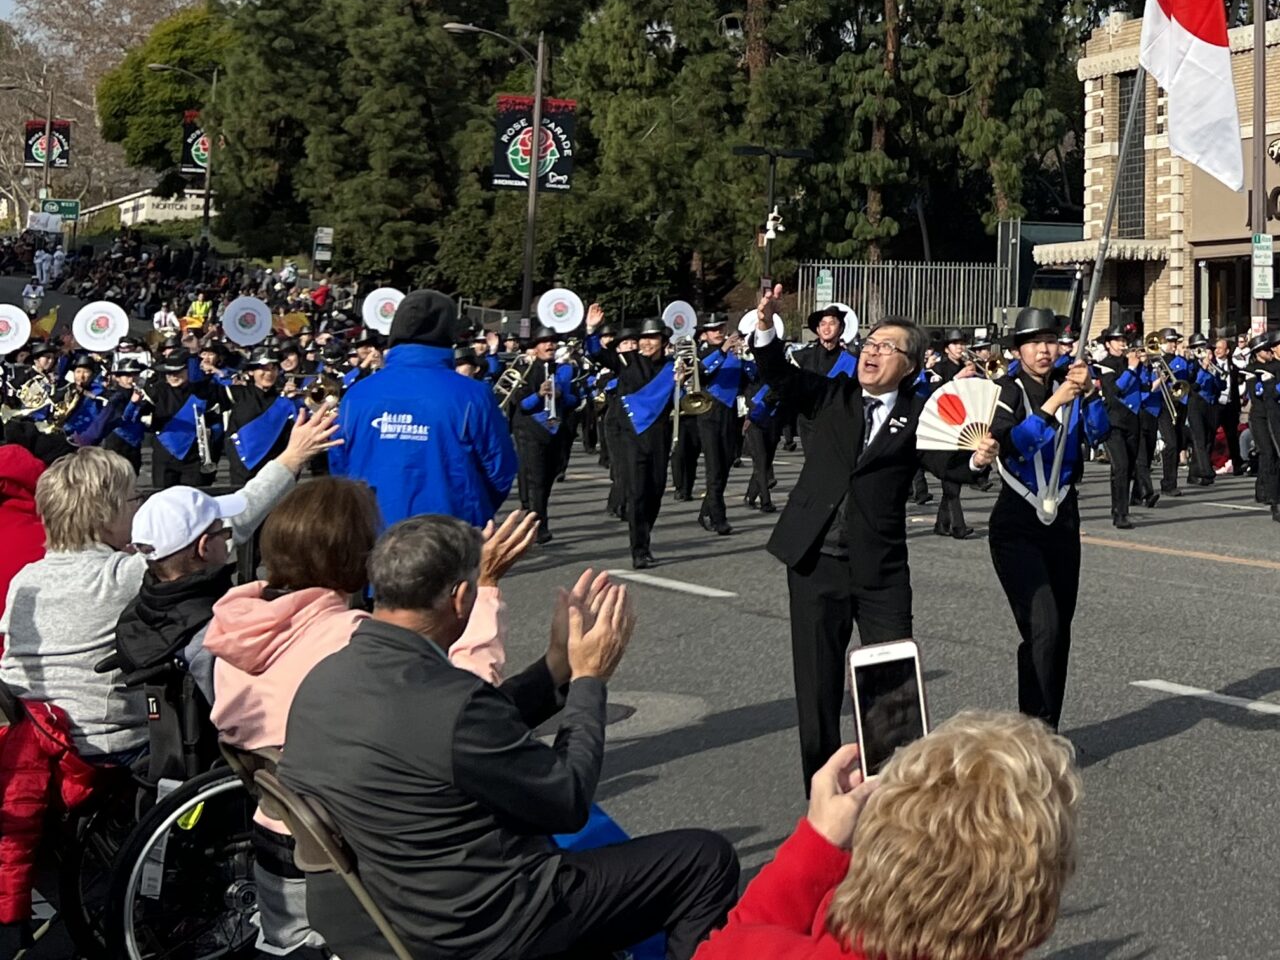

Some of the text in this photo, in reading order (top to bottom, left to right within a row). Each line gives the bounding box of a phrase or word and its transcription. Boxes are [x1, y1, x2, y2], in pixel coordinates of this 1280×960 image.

[501, 118, 572, 157] ROSE PARADE
[152, 202, 188, 210] NORTON
[382, 411, 413, 424] ALLIED
